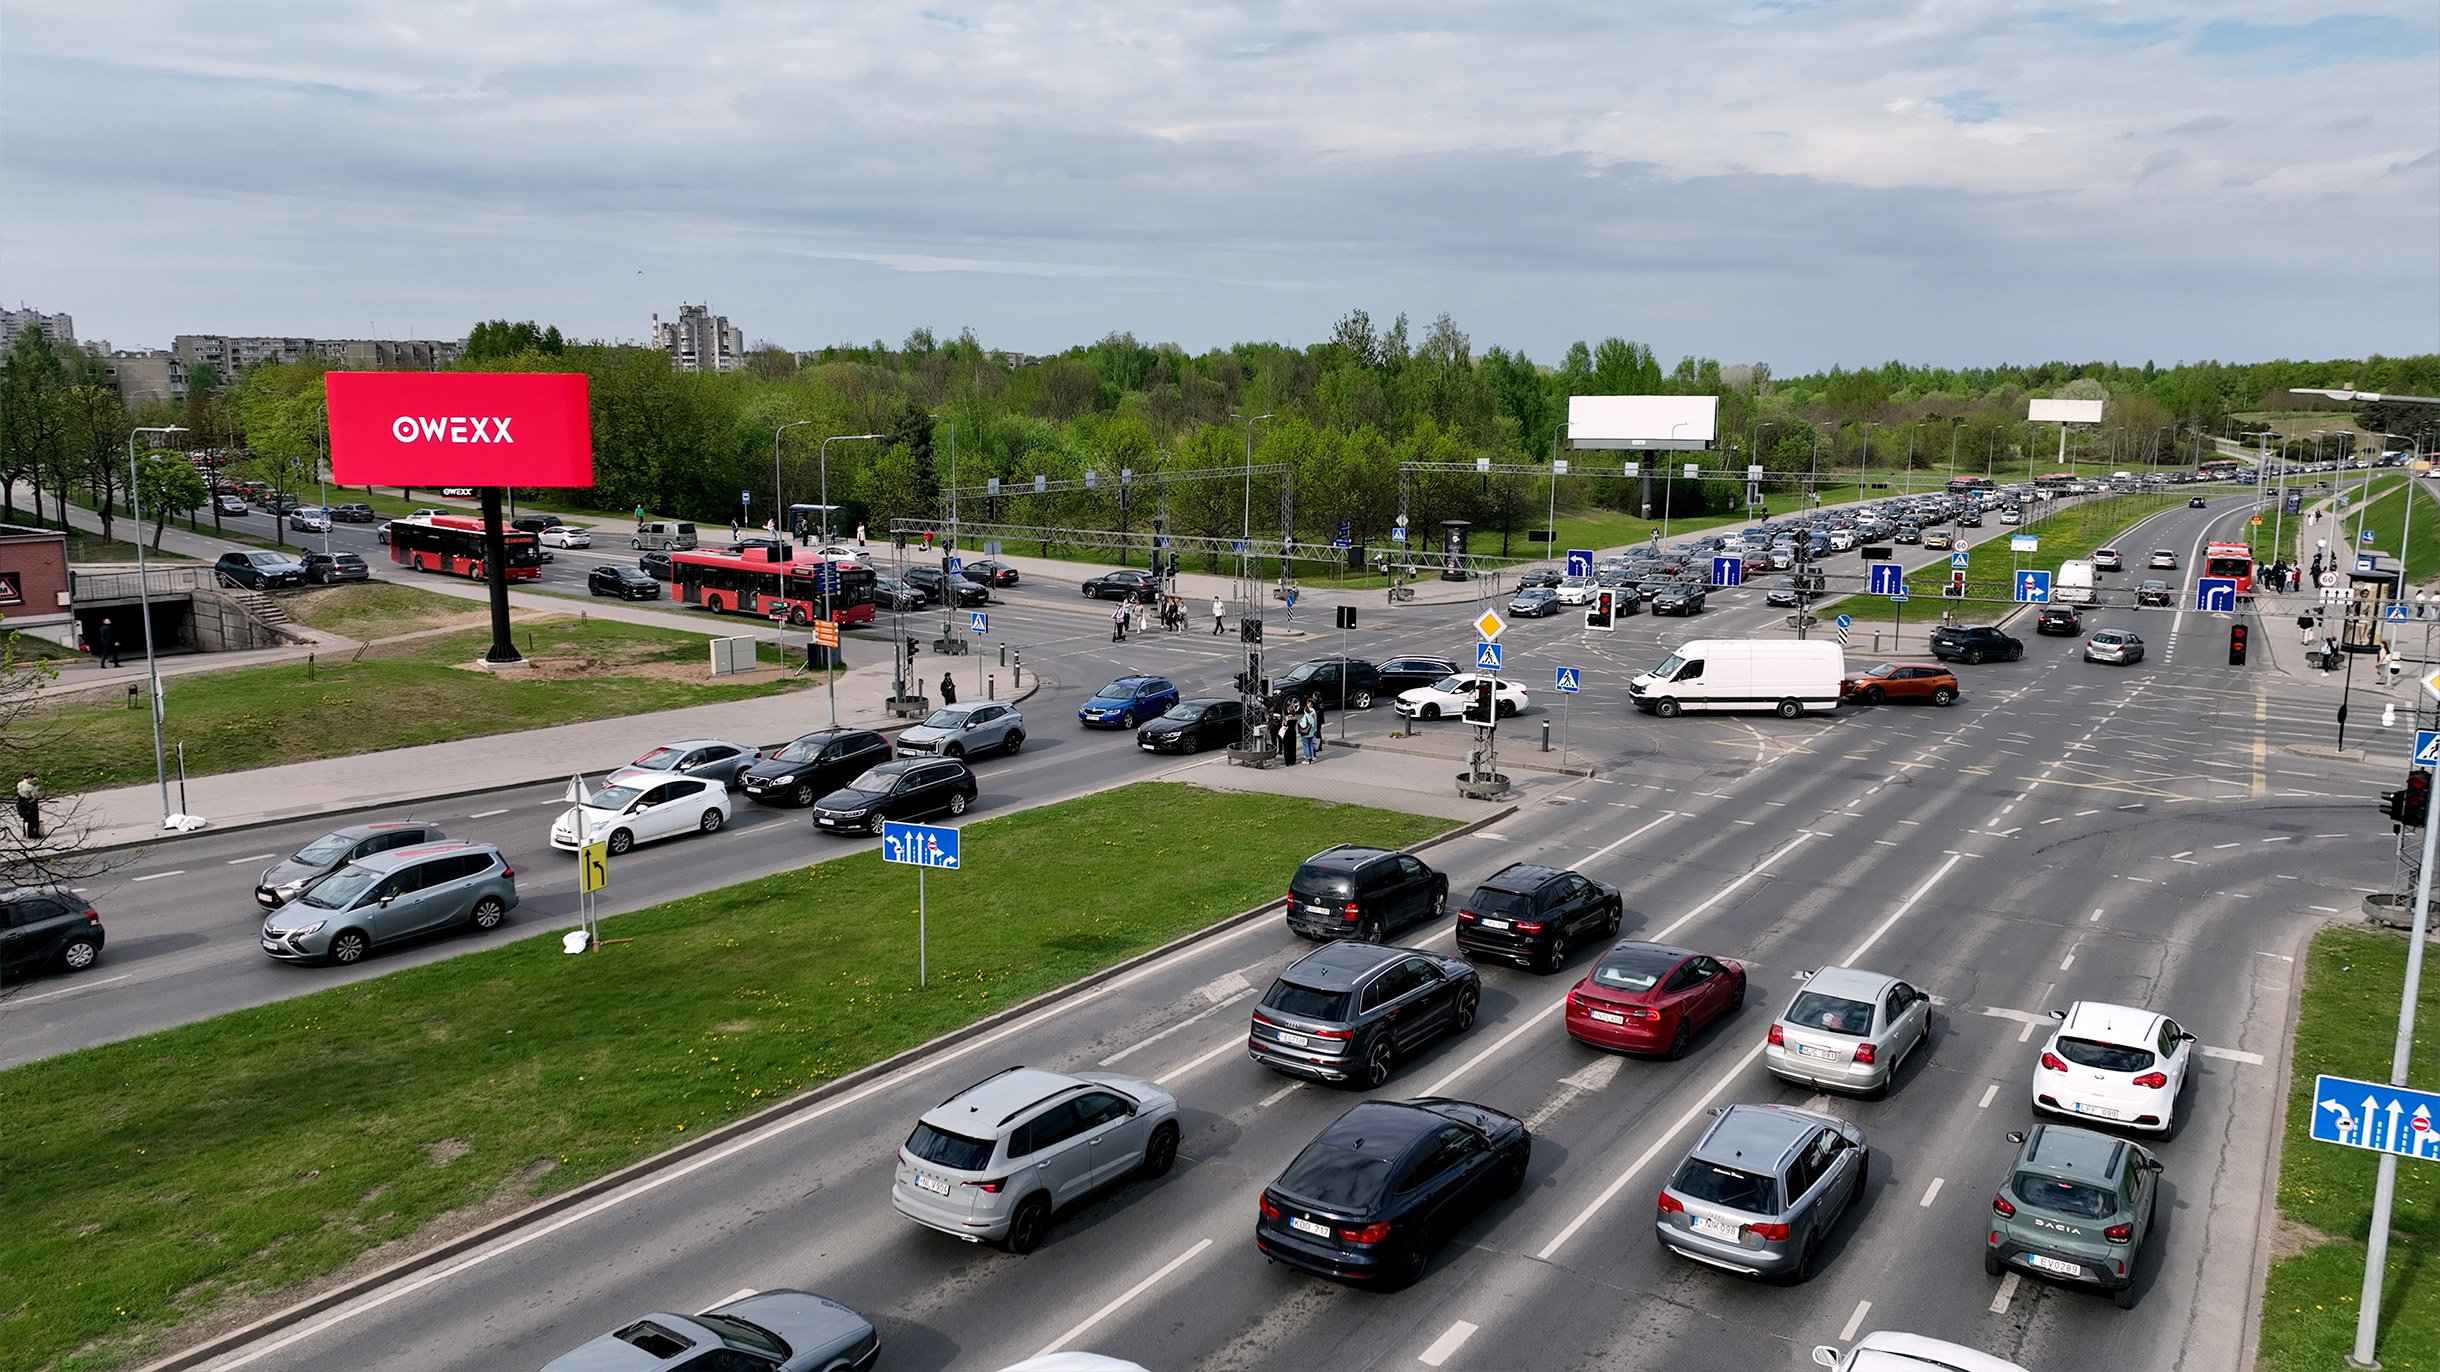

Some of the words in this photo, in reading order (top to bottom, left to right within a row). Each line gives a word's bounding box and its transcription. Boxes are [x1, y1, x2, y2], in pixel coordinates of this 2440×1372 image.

[392, 416, 514, 443] OWEXX
[2322, 575, 2334, 583] 60
[1314, 1225, 1329, 1236] 717
[1720, 1224, 1736, 1235] 098
[2035, 1218, 2081, 1235] DACIA
[2040, 1257, 2078, 1273] EV0289
